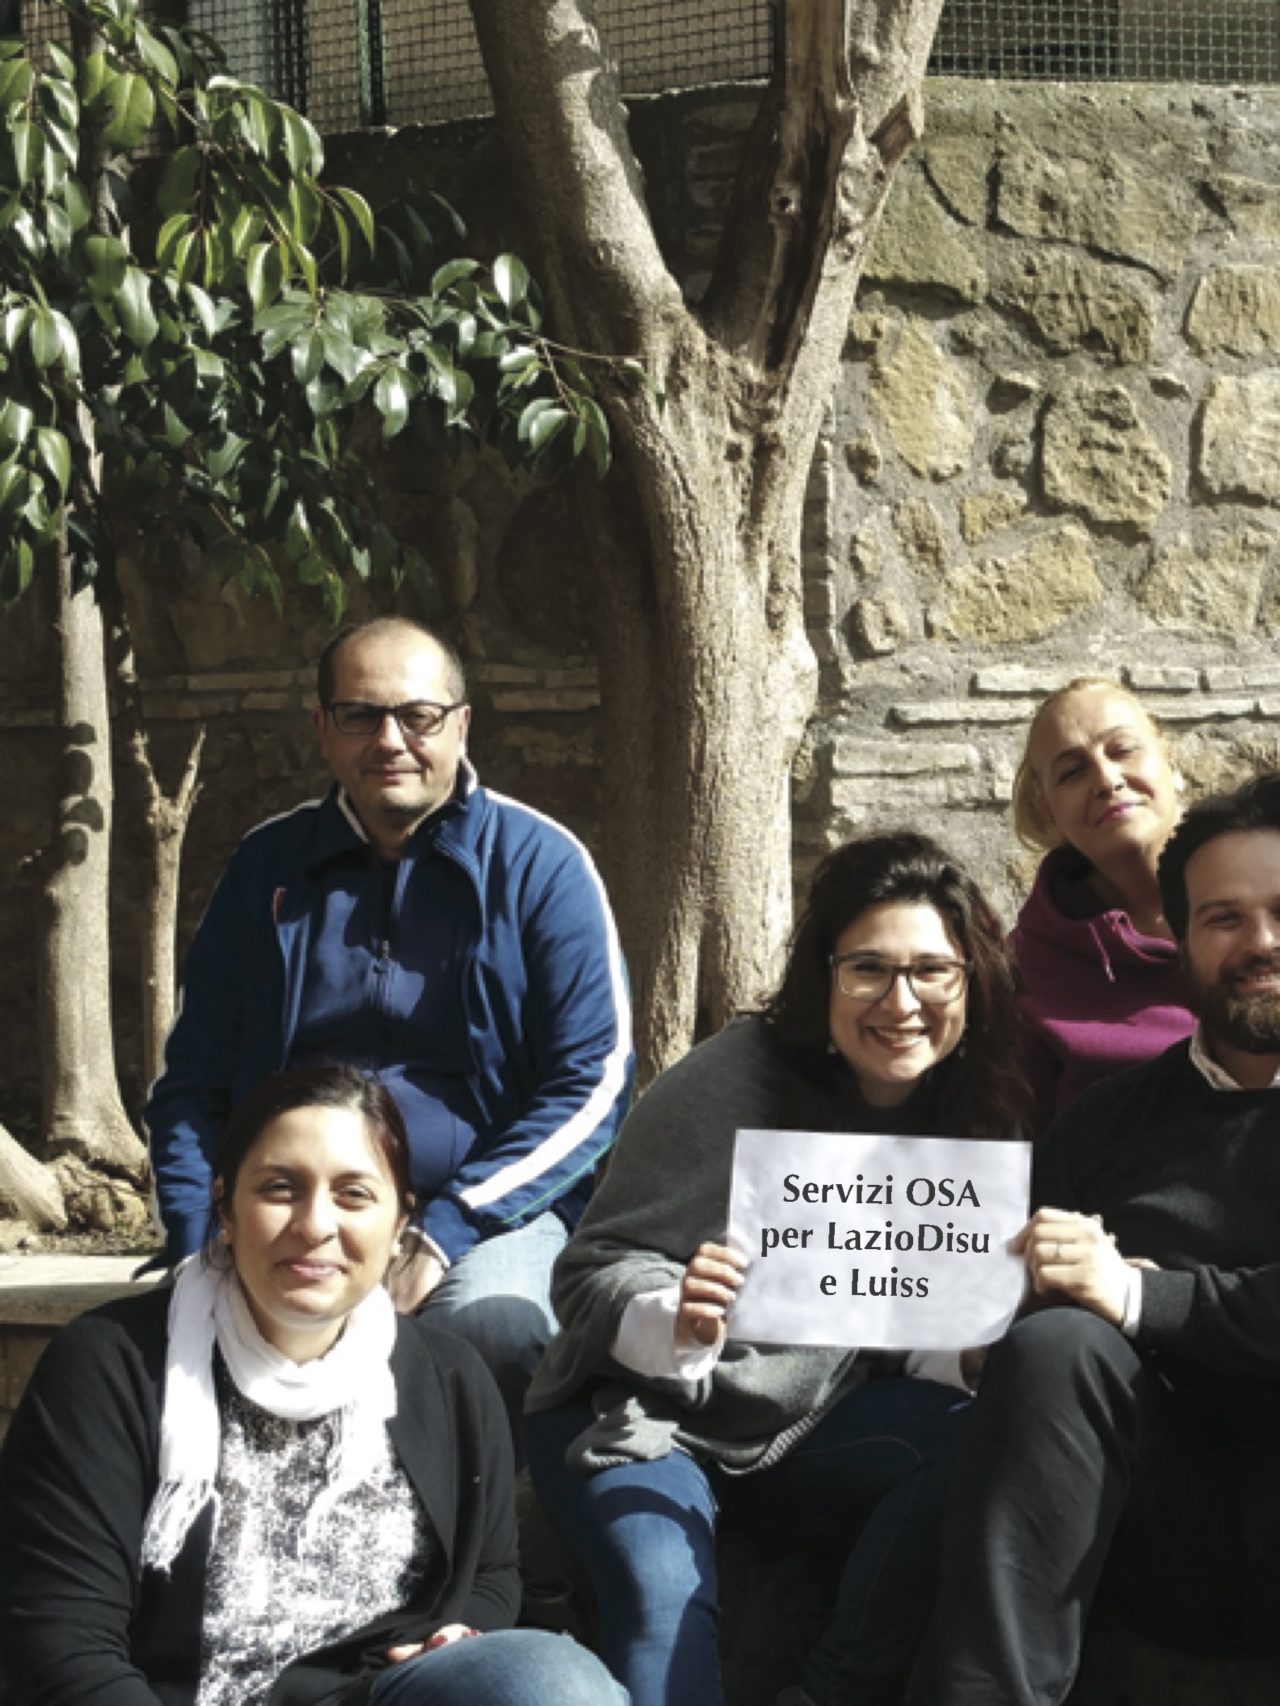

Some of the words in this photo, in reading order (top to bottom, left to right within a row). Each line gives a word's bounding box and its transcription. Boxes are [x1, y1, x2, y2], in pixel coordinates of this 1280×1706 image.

[783, 1174, 893, 1205] Servizi
[905, 1178, 981, 1208] OSA
[760, 1227, 814, 1258] per
[828, 1220, 990, 1254] LazioDisu
[819, 1274, 837, 1296] e
[851, 1266, 929, 1298] Luiss
